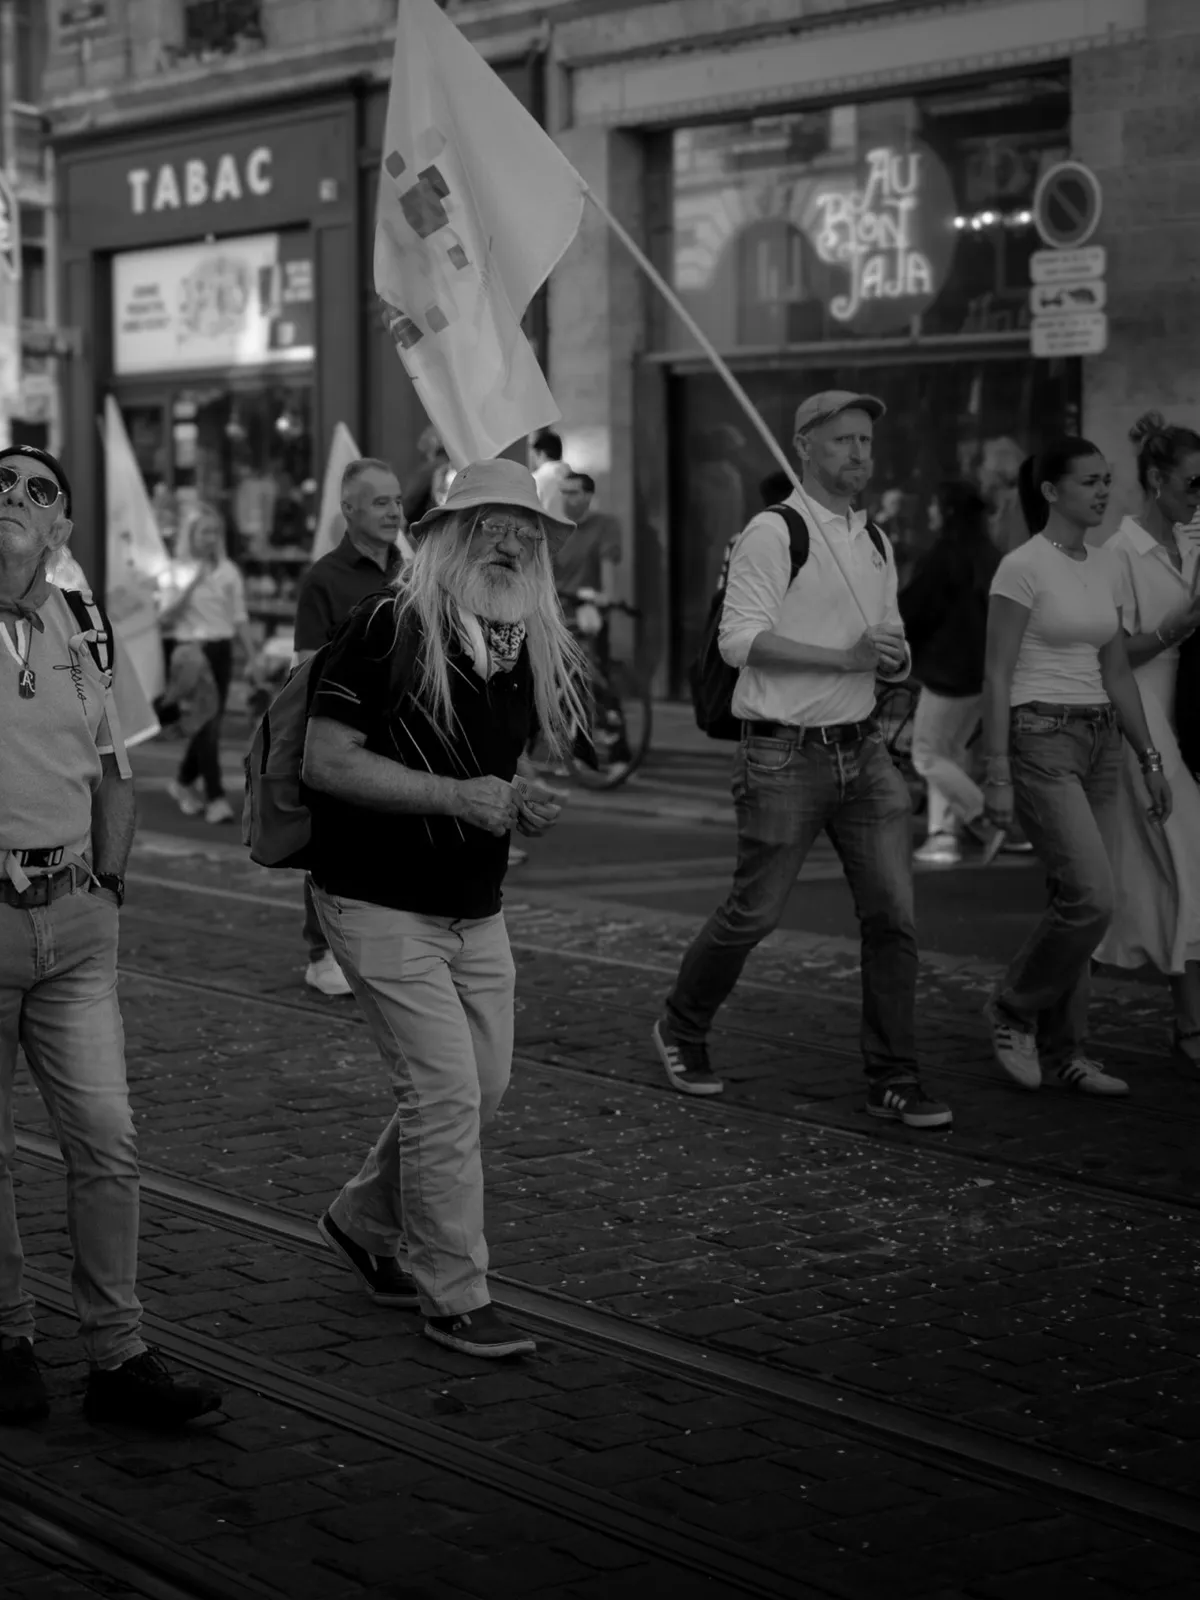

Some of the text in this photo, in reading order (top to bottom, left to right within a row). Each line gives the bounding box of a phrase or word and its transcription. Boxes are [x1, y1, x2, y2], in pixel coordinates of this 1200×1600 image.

[128, 147, 273, 214] TABAC
[852, 147, 922, 212] AU
[816, 193, 915, 263] BON
[831, 244, 933, 321] JAJA
